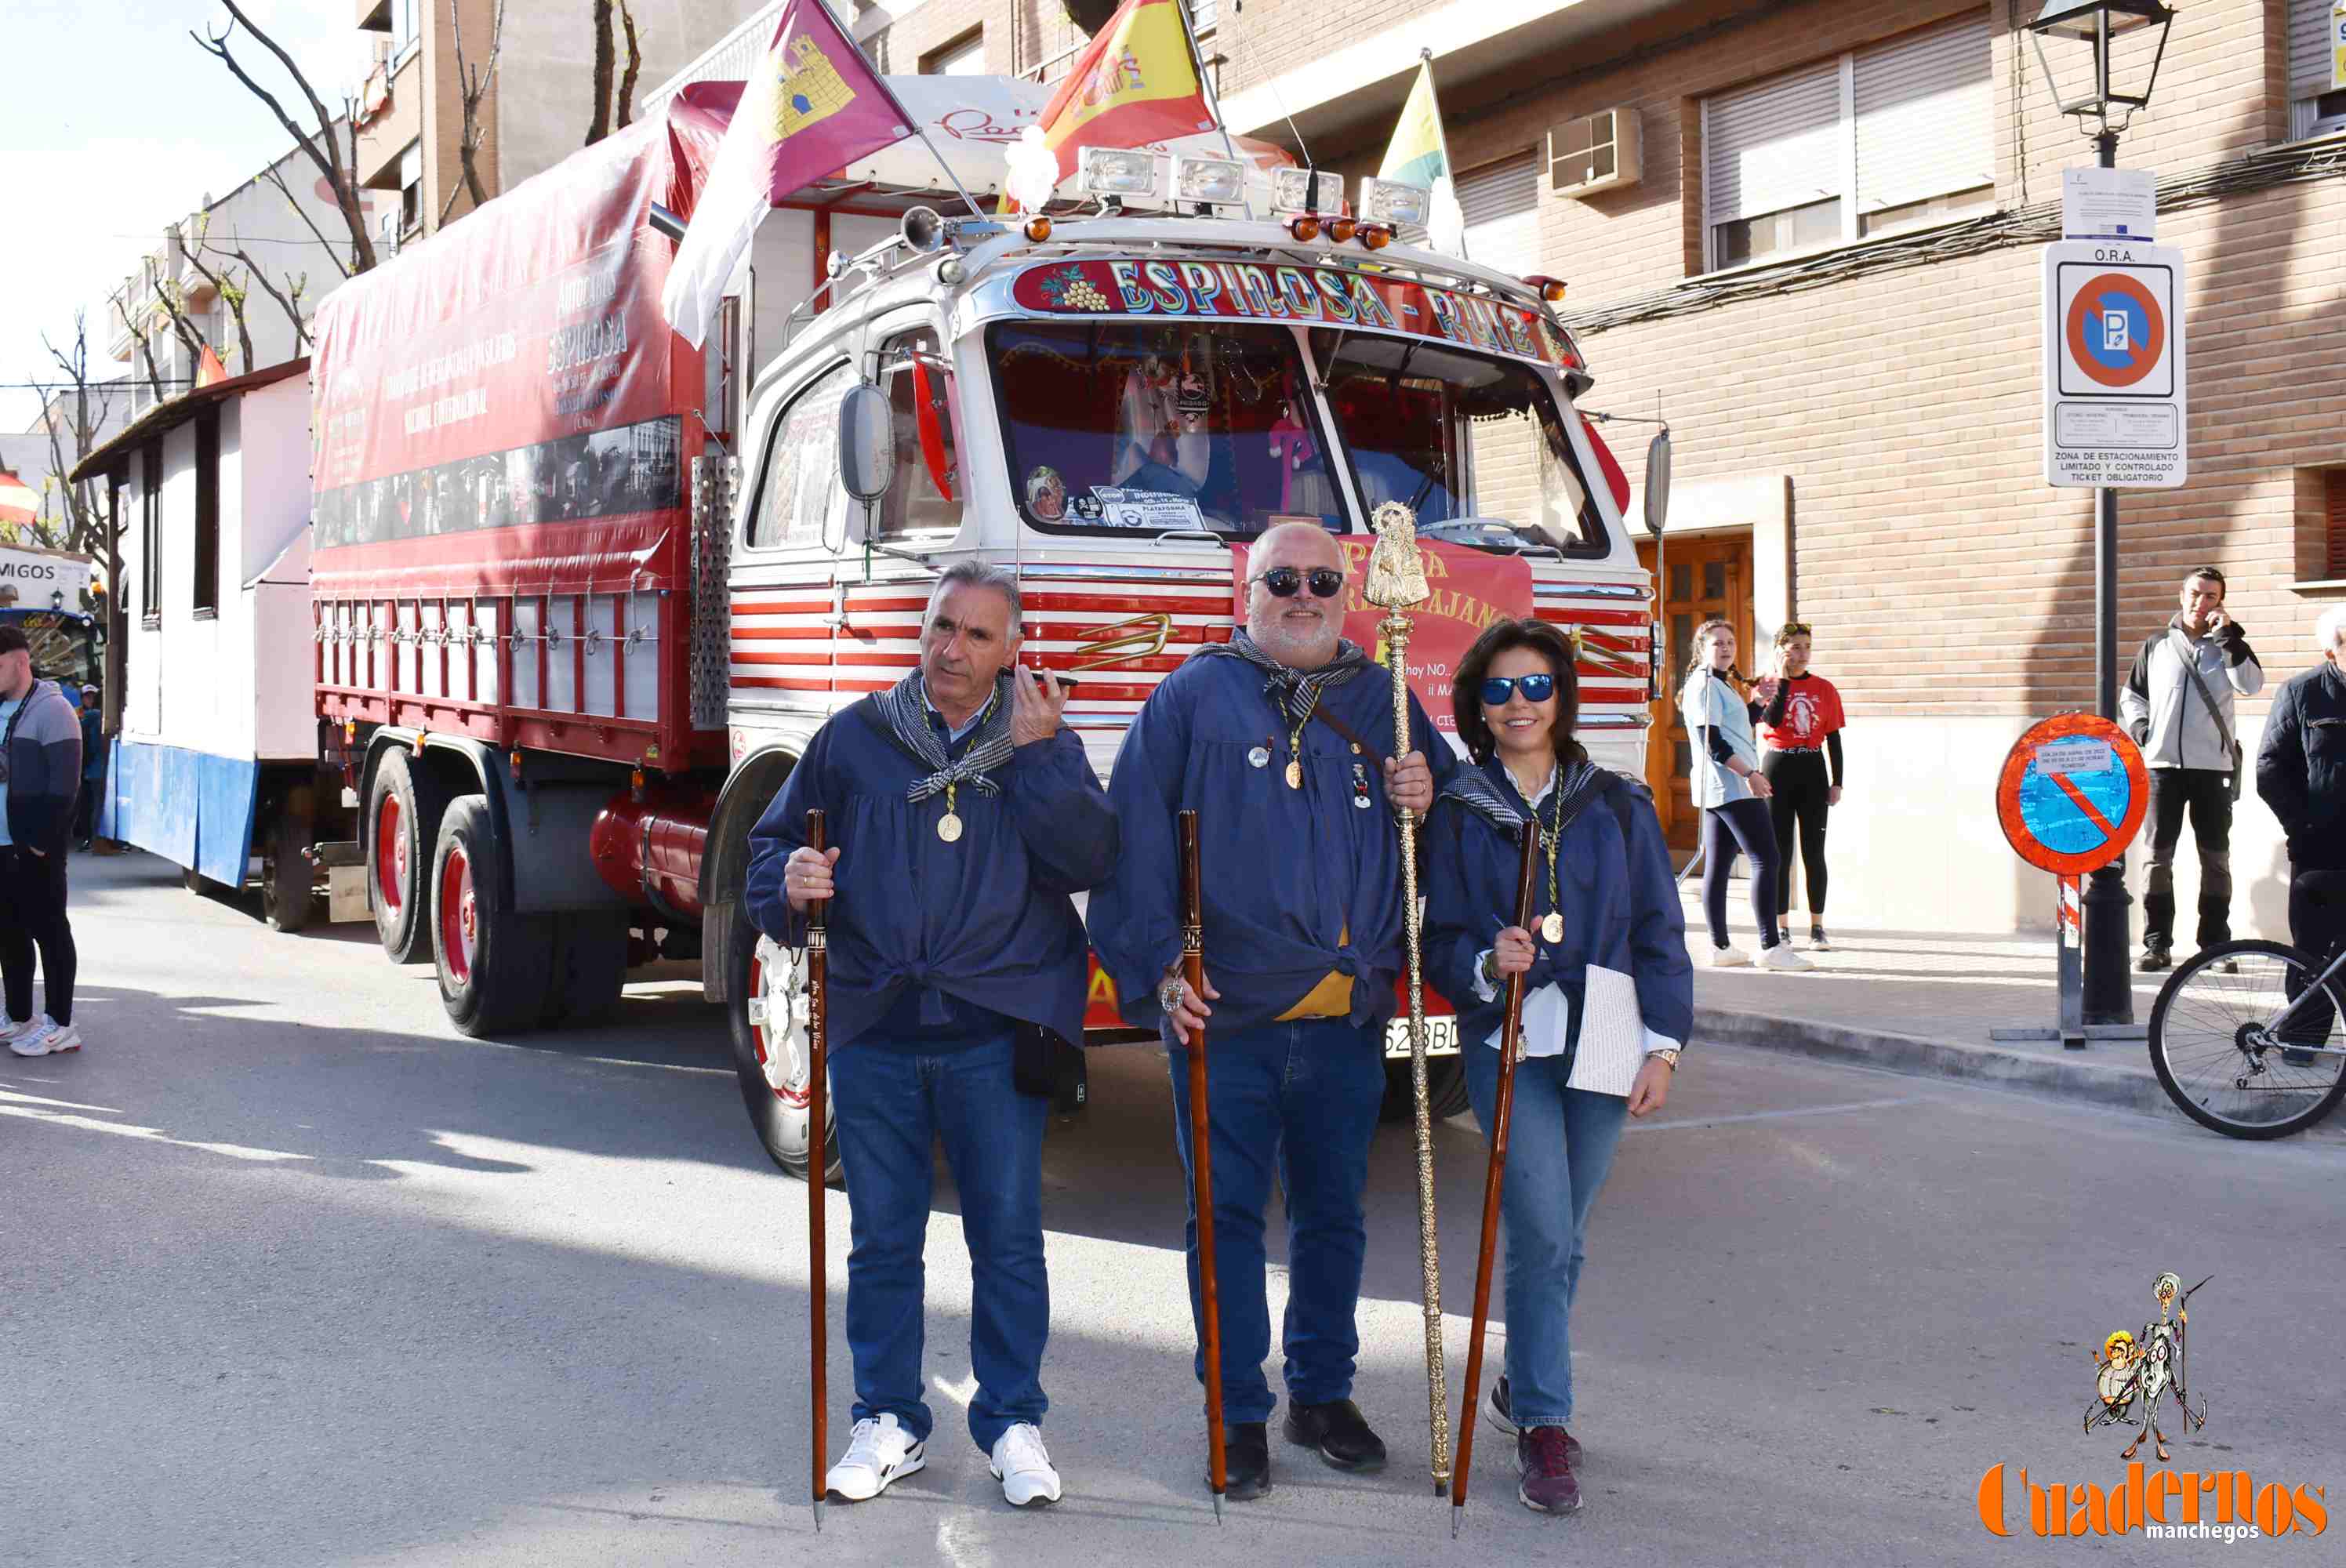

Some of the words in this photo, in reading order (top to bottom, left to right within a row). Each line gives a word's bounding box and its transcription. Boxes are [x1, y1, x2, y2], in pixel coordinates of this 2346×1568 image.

[2095, 249, 2136, 262] O.R.A.
[1108, 260, 1397, 326] ESPINOSA
[1423, 286, 1546, 359] RUIZ
[2098, 452, 2179, 461] ESTACIONAMIENTO
[2072, 473, 2101, 481] TICKET
